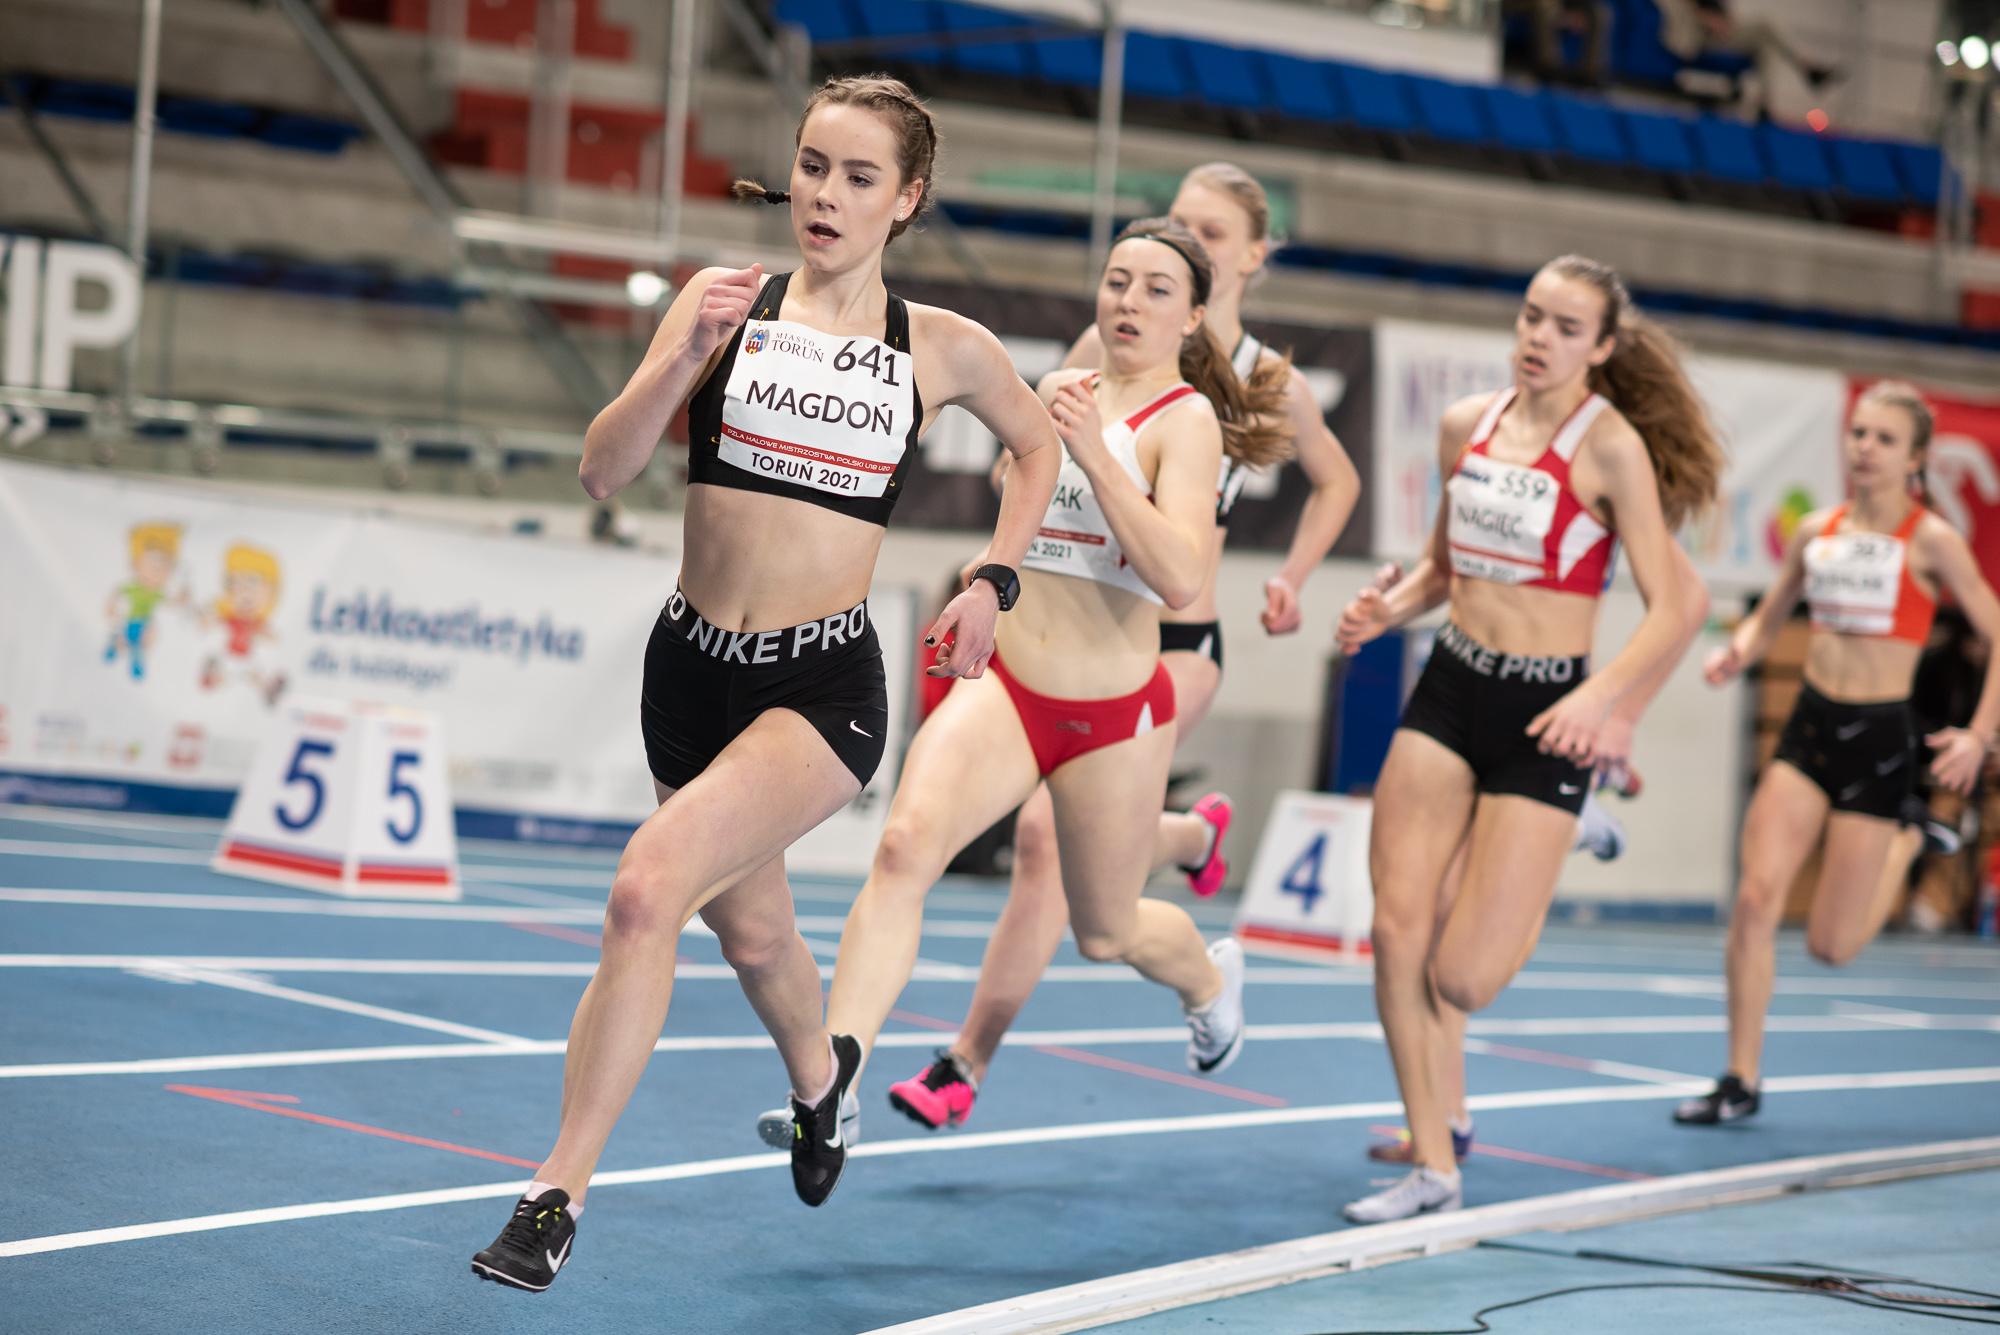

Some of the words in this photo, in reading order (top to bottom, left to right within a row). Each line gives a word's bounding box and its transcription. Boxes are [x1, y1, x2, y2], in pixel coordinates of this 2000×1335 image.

[0, 233, 140, 390] IP
[771, 339, 825, 363] TORUŃ
[775, 332, 815, 347] MIASTO
[833, 340, 900, 387] 641
[746, 380, 893, 436] MAGDOŃ
[727, 428, 745, 440] PZLA
[746, 436, 778, 449] HALOWE
[779, 444, 836, 462] MISTRZOSTWA
[836, 456, 865, 468] POLSKI
[864, 462, 878, 471] U18
[752, 452, 813, 481] TORUŃ
[817, 469, 860, 491] 2021
[1499, 470, 1548, 500] 559
[1042, 542, 1071, 559] 2021
[686, 615, 783, 665] NIKE
[791, 602, 865, 659] PRO
[1437, 621, 1499, 676] NIKE
[1499, 652, 1573, 684] PRO
[274, 739, 335, 833] 5
[385, 750, 424, 845] 5
[1279, 830, 1328, 917] 4
